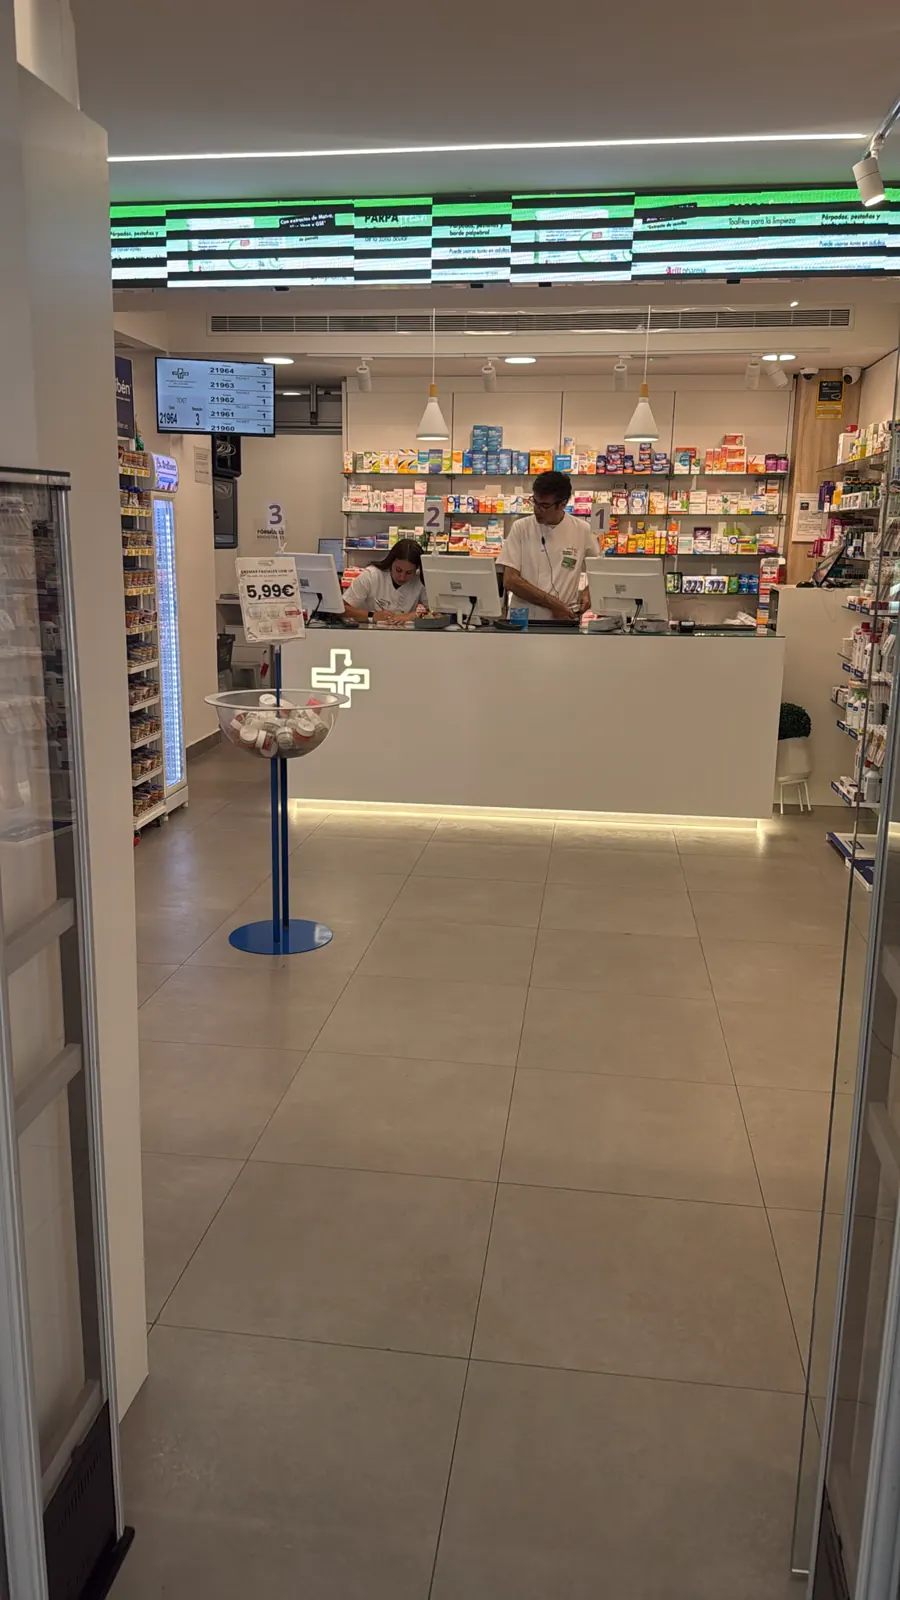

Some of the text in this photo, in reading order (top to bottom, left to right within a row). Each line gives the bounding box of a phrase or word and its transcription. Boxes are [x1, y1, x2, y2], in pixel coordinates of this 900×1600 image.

[751, 218, 764, 226] para
[772, 216, 796, 226] limpieza
[465, 229, 490, 237] palpebral
[209, 367, 235, 375] 21964
[210, 381, 235, 389] 21963
[159, 412, 200, 426] 21964 3
[268, 504, 283, 525] 3
[426, 507, 440, 527] 2
[595, 509, 605, 529] 1
[246, 583, 295, 600] 5,99€
